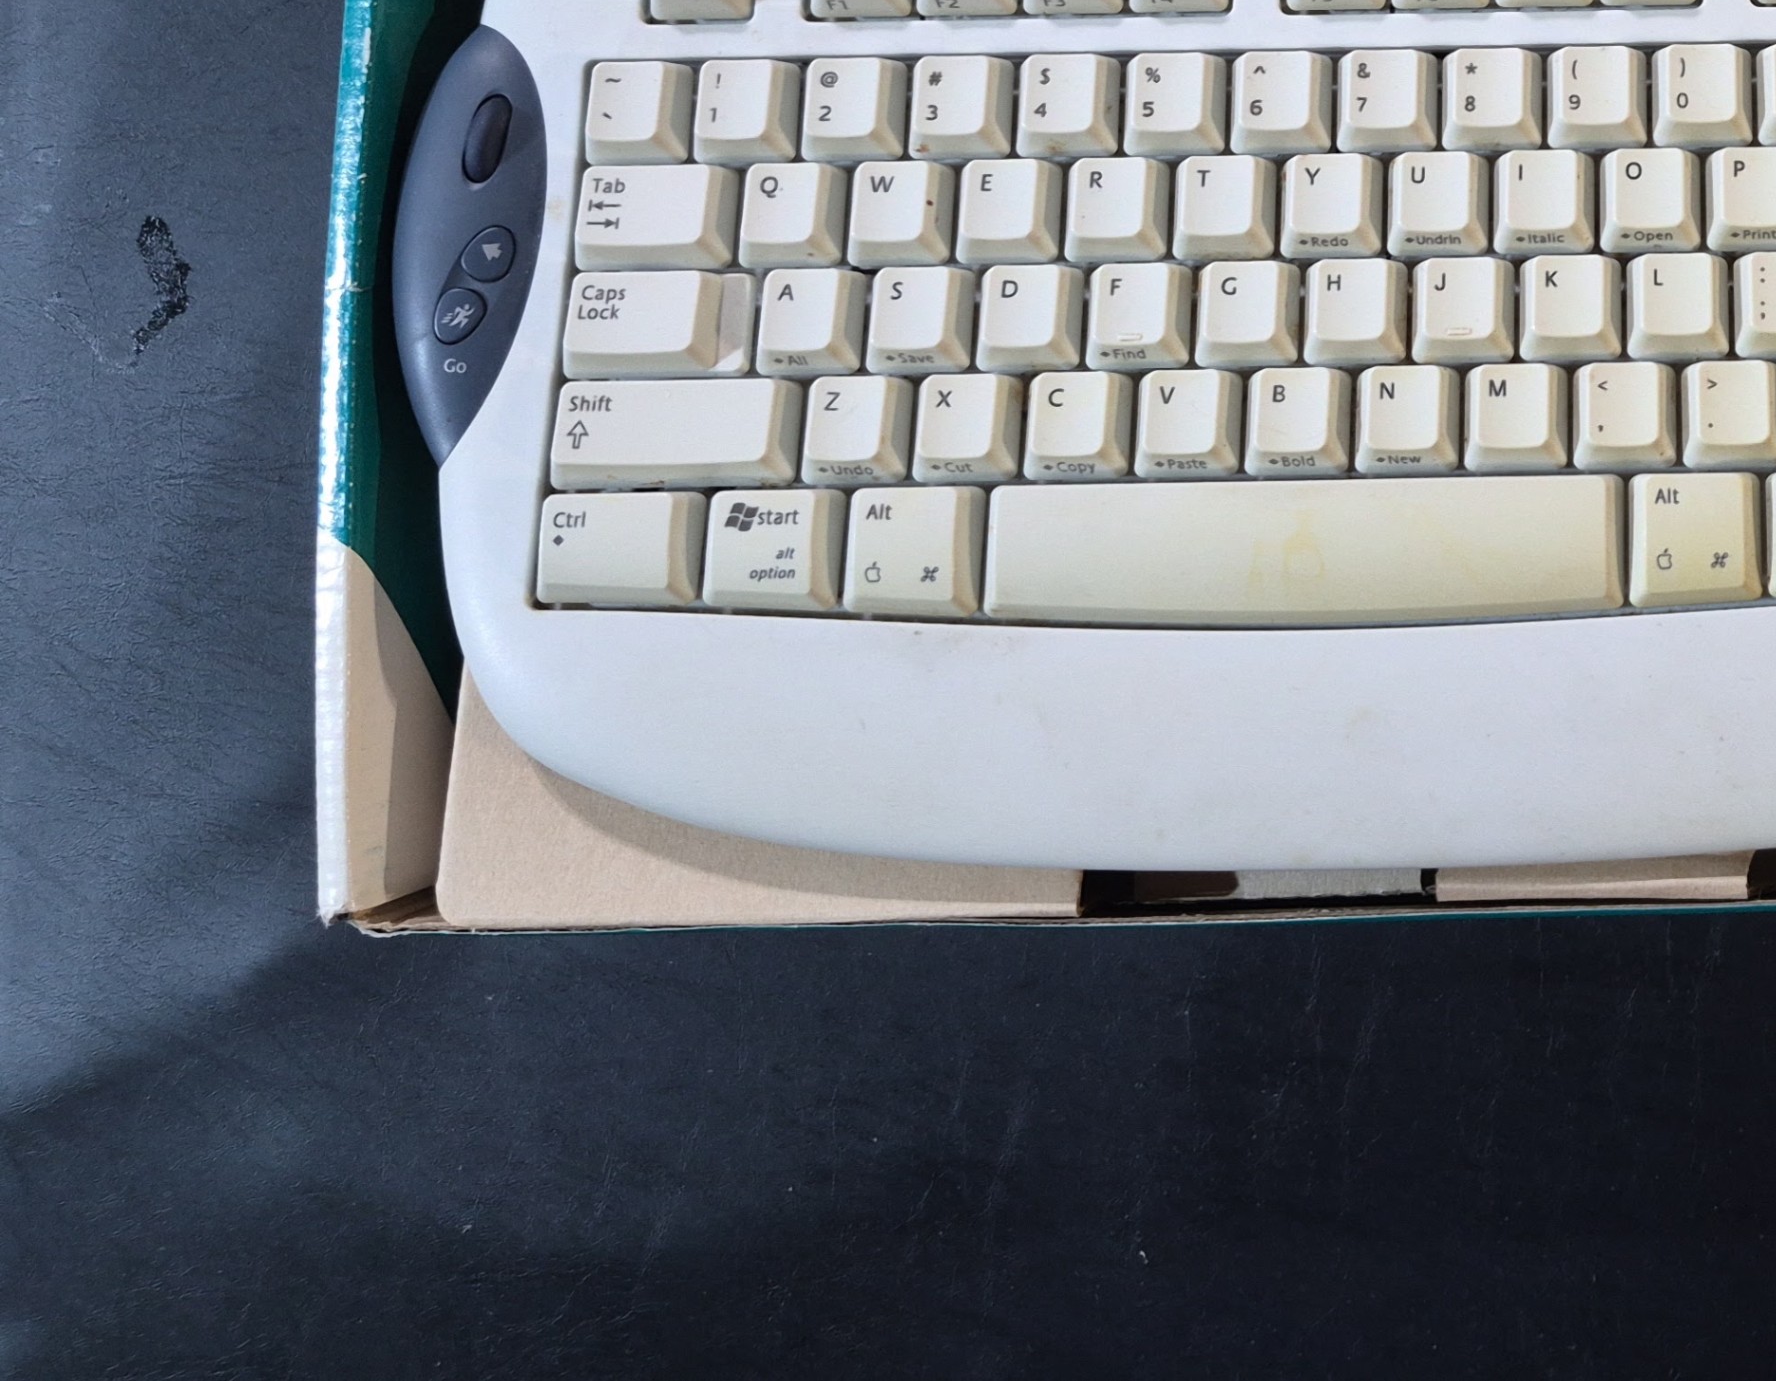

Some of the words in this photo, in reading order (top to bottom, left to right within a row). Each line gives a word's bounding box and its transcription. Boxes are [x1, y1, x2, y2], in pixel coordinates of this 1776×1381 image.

[1304, 167, 1321, 186] Y
[1410, 166, 1426, 185] U
[1733, 159, 1746, 178] P
[592, 177, 626, 194] Tab
[759, 175, 779, 199] Q
[869, 175, 895, 193] W
[980, 173, 994, 192] E
[1089, 170, 1103, 189] R
[1196, 169, 1211, 188] T
[1310, 235, 1349, 248] Redo
[1527, 232, 1565, 244] Italic
[1633, 230, 1674, 244] Open
[581, 284, 626, 305] Caps
[777, 283, 794, 302] A
[1109, 278, 1123, 297] F
[577, 303, 620, 321] Lock
[897, 352, 935, 364] Save
[1111, 348, 1147, 361] Find
[442, 357, 467, 374] Go
[1047, 387, 1065, 408] C
[1159, 385, 1176, 405] V
[1272, 384, 1286, 403] B
[1379, 381, 1395, 400] N
[1488, 379, 1507, 398] M
[568, 395, 613, 413] Shift
[943, 461, 974, 474] Cut
[1056, 461, 1097, 476] Copy
[1166, 458, 1208, 470] Paste
[1280, 455, 1316, 468] Bold
[1387, 455, 1422, 465] New
[830, 463, 874, 476] Undo
[1654, 487, 1680, 505] Alt
[552, 511, 587, 529] Ctrl
[757, 509, 800, 526] start
[865, 503, 893, 521] Alt
[775, 546, 796, 560] alt
[748, 566, 796, 583] option
